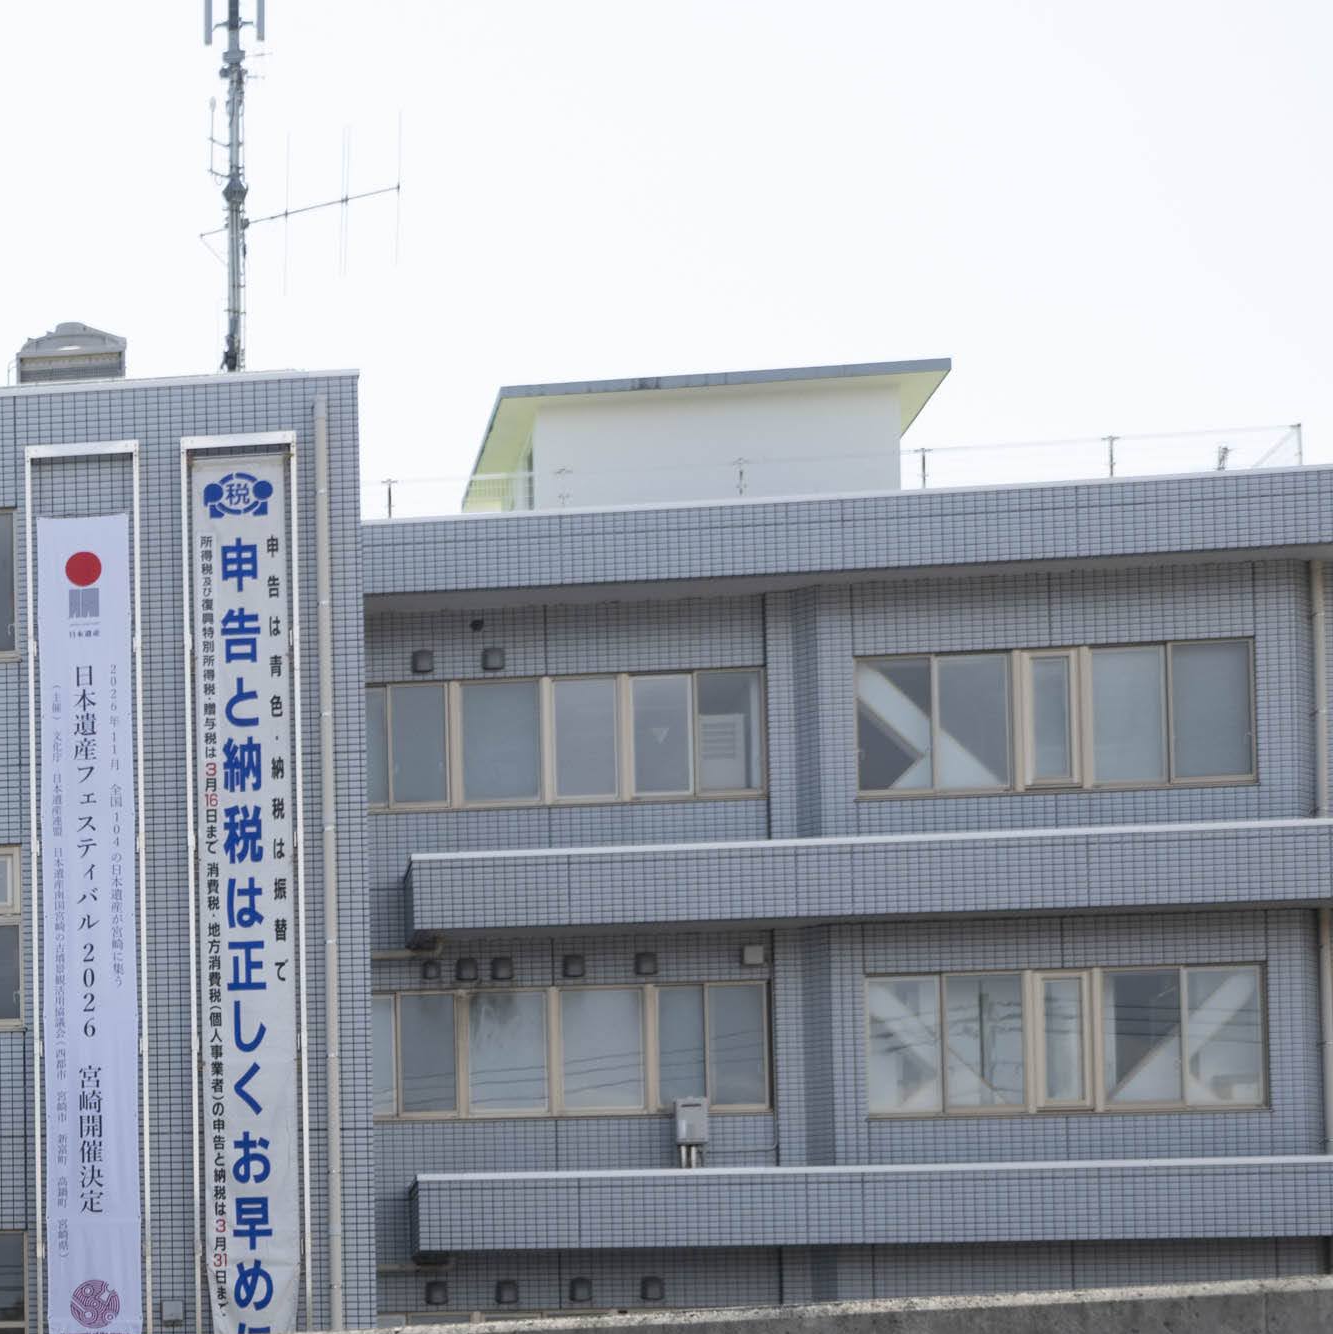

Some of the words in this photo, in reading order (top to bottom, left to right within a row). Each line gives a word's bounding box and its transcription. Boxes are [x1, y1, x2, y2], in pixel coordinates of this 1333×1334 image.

[226, 483, 250, 505] 税
[109, 664, 120, 771] 2026年11月
[267, 535, 289, 982] 申告は青色・納税は振替で
[73, 665, 101, 1038] 日本遺産フェスティバル2026
[220, 537, 274, 1334] 申告と納税は正しくお早め
[78, 1065, 104, 1214] 宮崎開催決定
